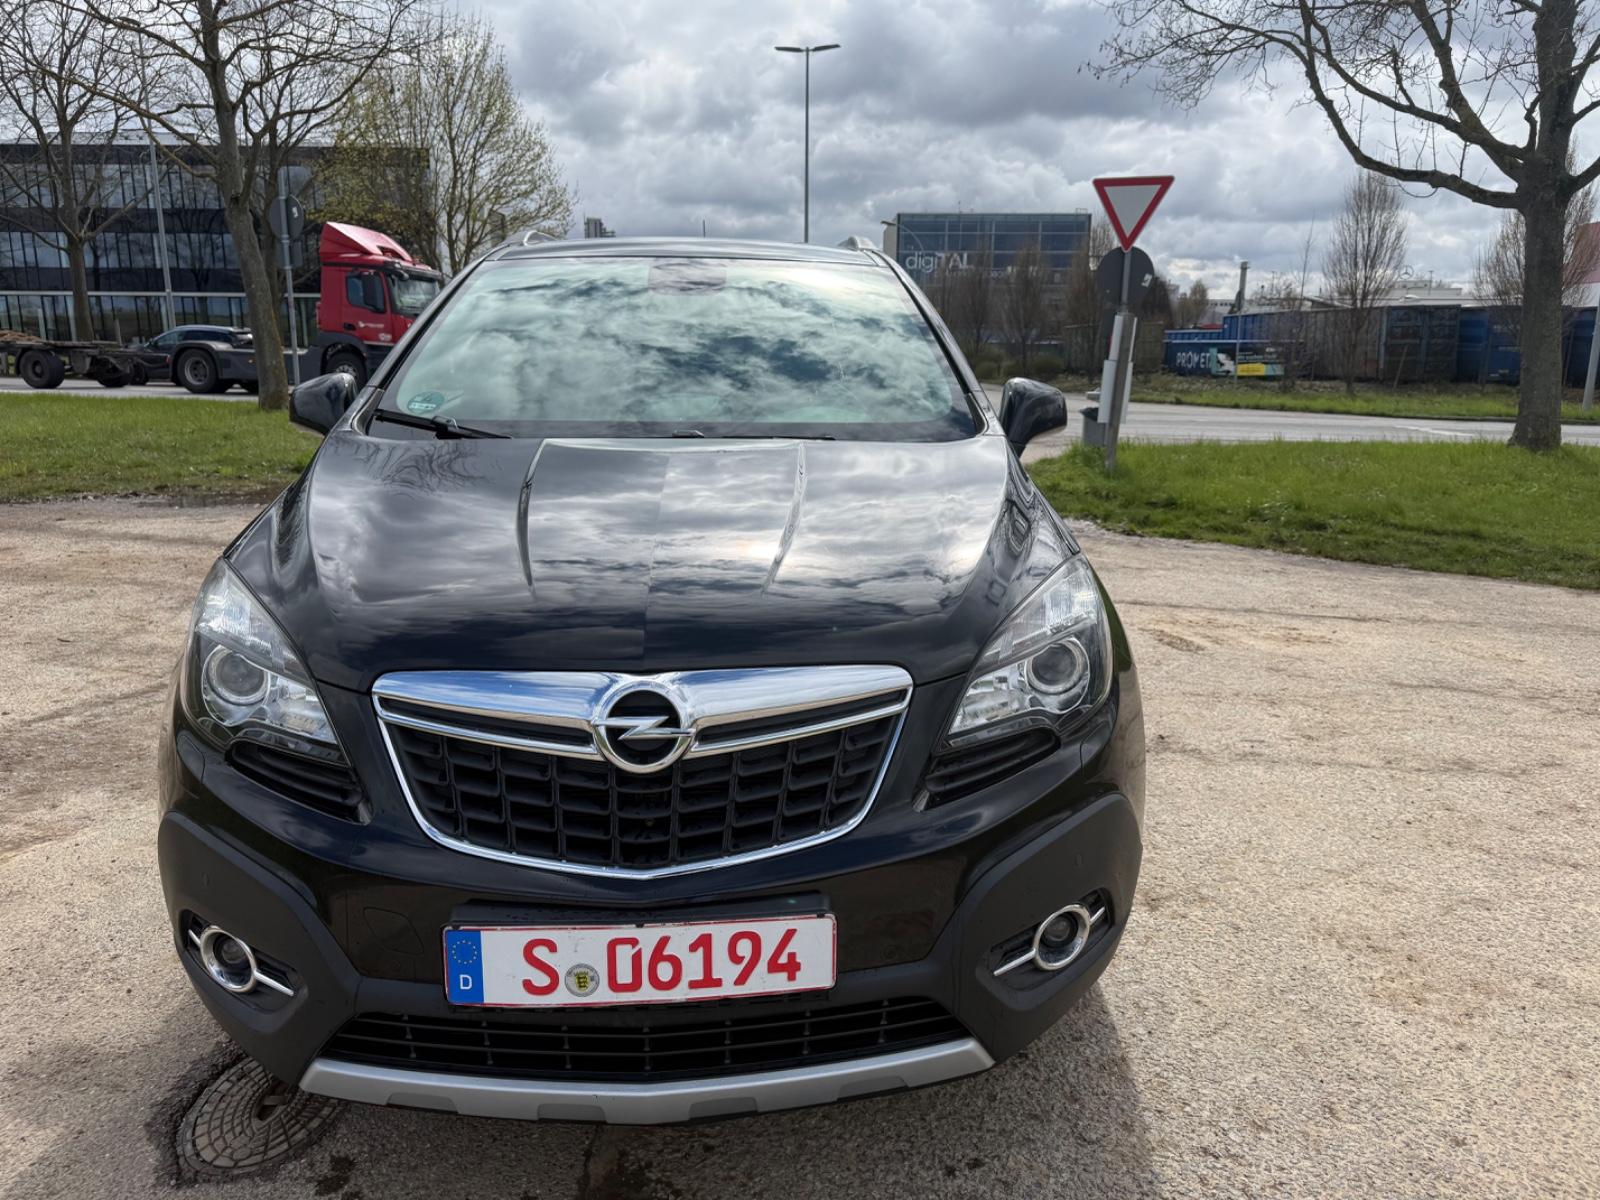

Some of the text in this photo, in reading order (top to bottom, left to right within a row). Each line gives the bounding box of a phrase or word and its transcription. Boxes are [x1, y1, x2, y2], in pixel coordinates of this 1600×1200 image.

[459, 974, 473, 990] D
[521, 938, 560, 996] S
[607, 928, 801, 993] 06194
